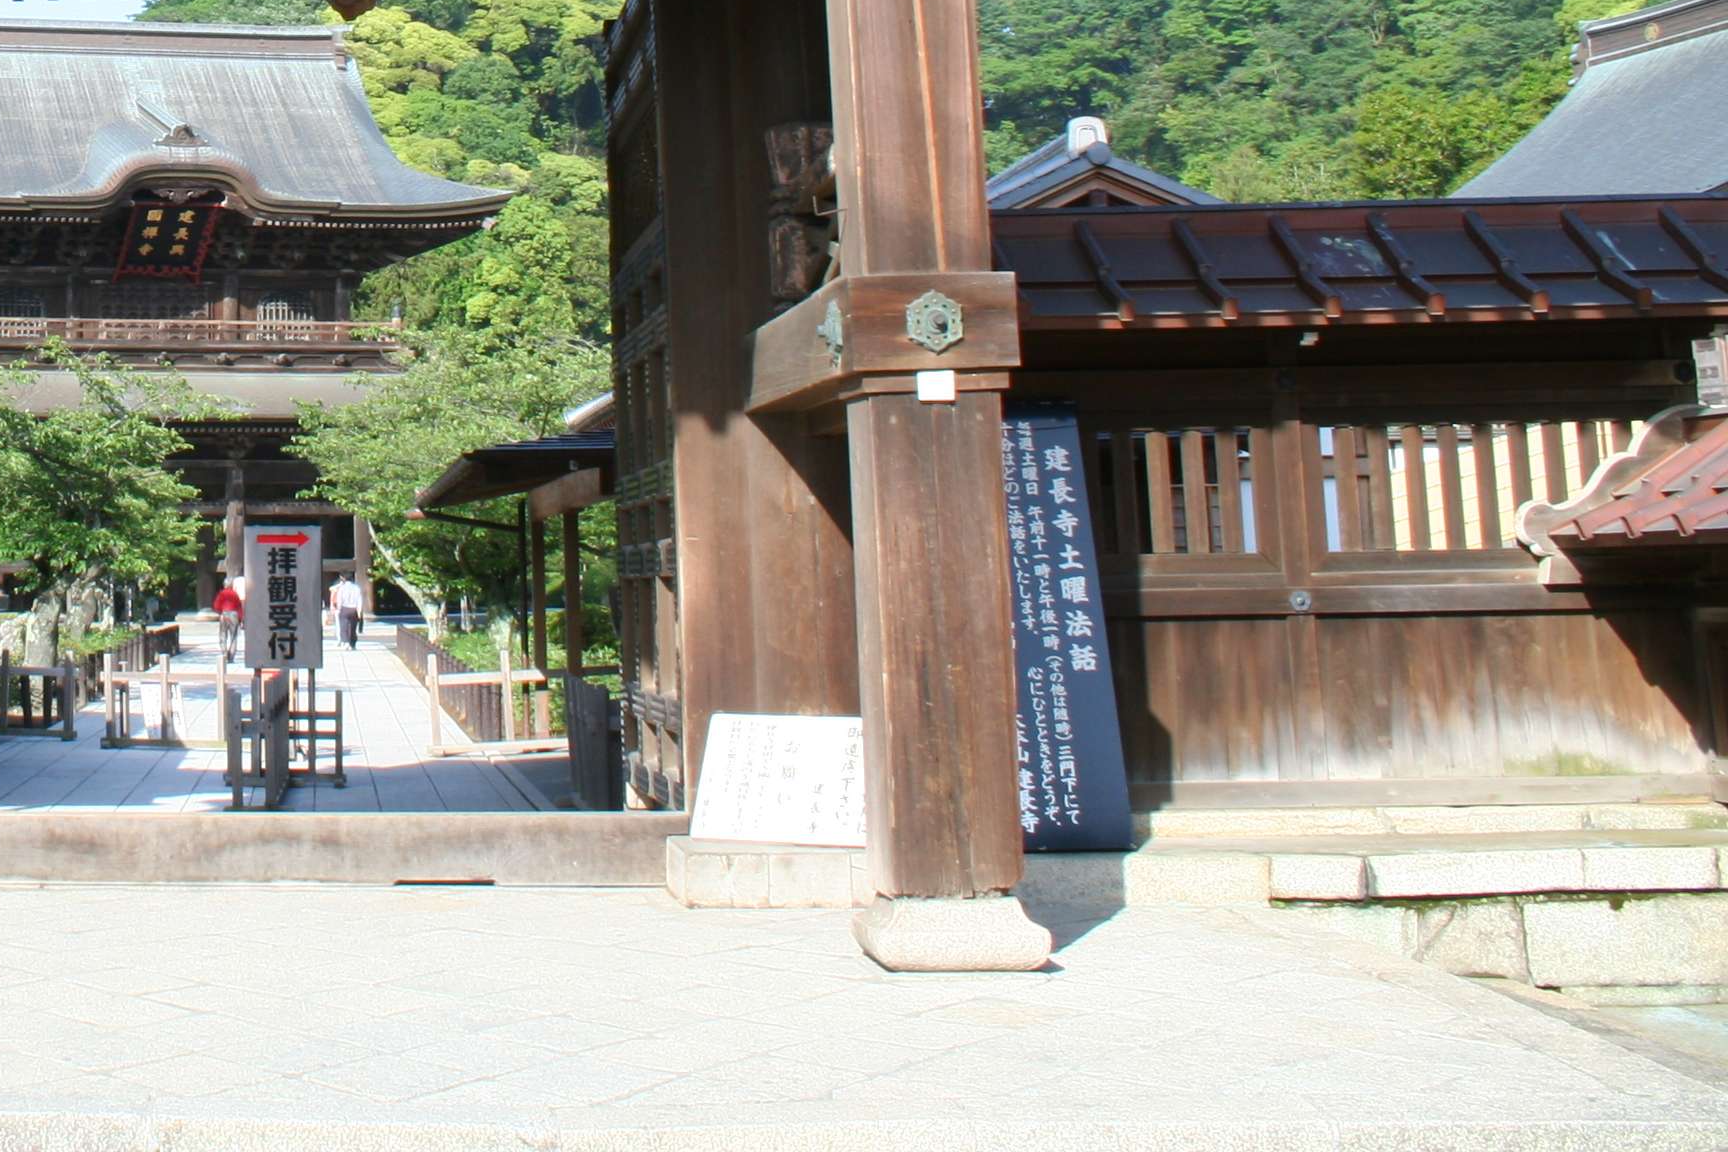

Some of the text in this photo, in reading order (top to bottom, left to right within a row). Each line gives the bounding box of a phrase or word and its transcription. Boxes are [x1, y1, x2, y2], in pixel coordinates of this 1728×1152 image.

[267, 547, 298, 661] 拝観受付
[1043, 445, 1098, 672] 建長寺土曜法話
